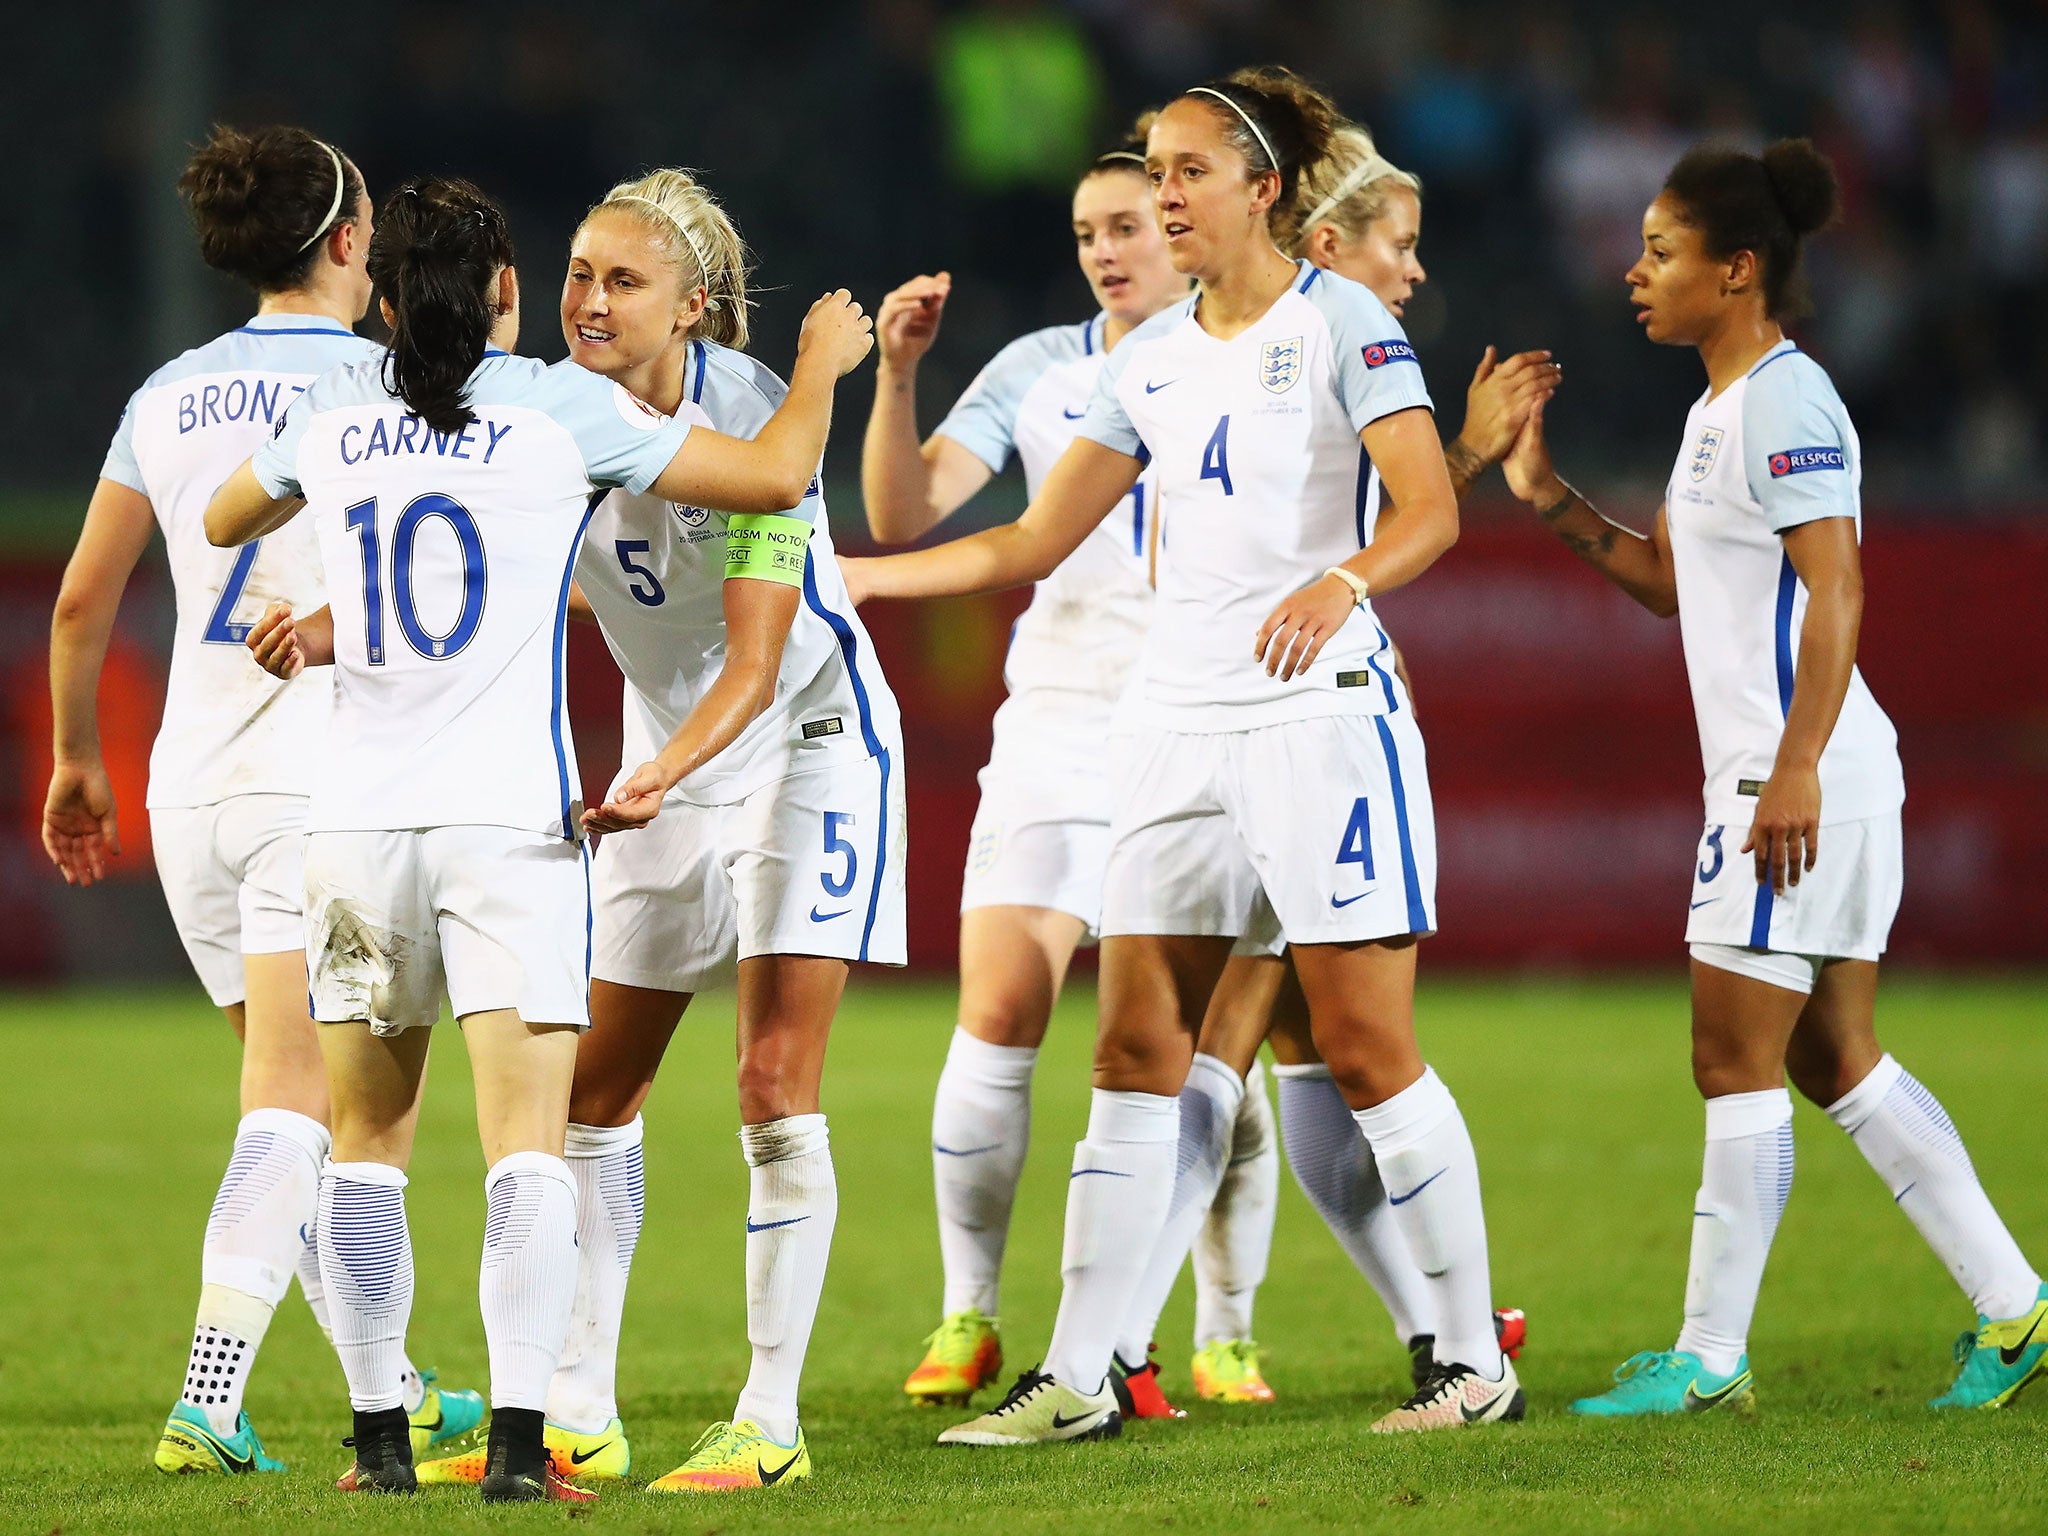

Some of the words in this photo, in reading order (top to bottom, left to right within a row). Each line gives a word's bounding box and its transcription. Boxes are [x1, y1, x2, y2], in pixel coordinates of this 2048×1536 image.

[340, 415, 513, 466] CARNEY
[1200, 414, 1234, 496] 4
[1790, 451, 1843, 467] RESPECT
[614, 539, 666, 607] 5
[767, 531, 787, 544] NO
[789, 535, 802, 547] TO
[344, 491, 489, 667] 10
[820, 811, 857, 898] 5
[1335, 797, 1376, 881] 4
[1698, 825, 1725, 884] 3
